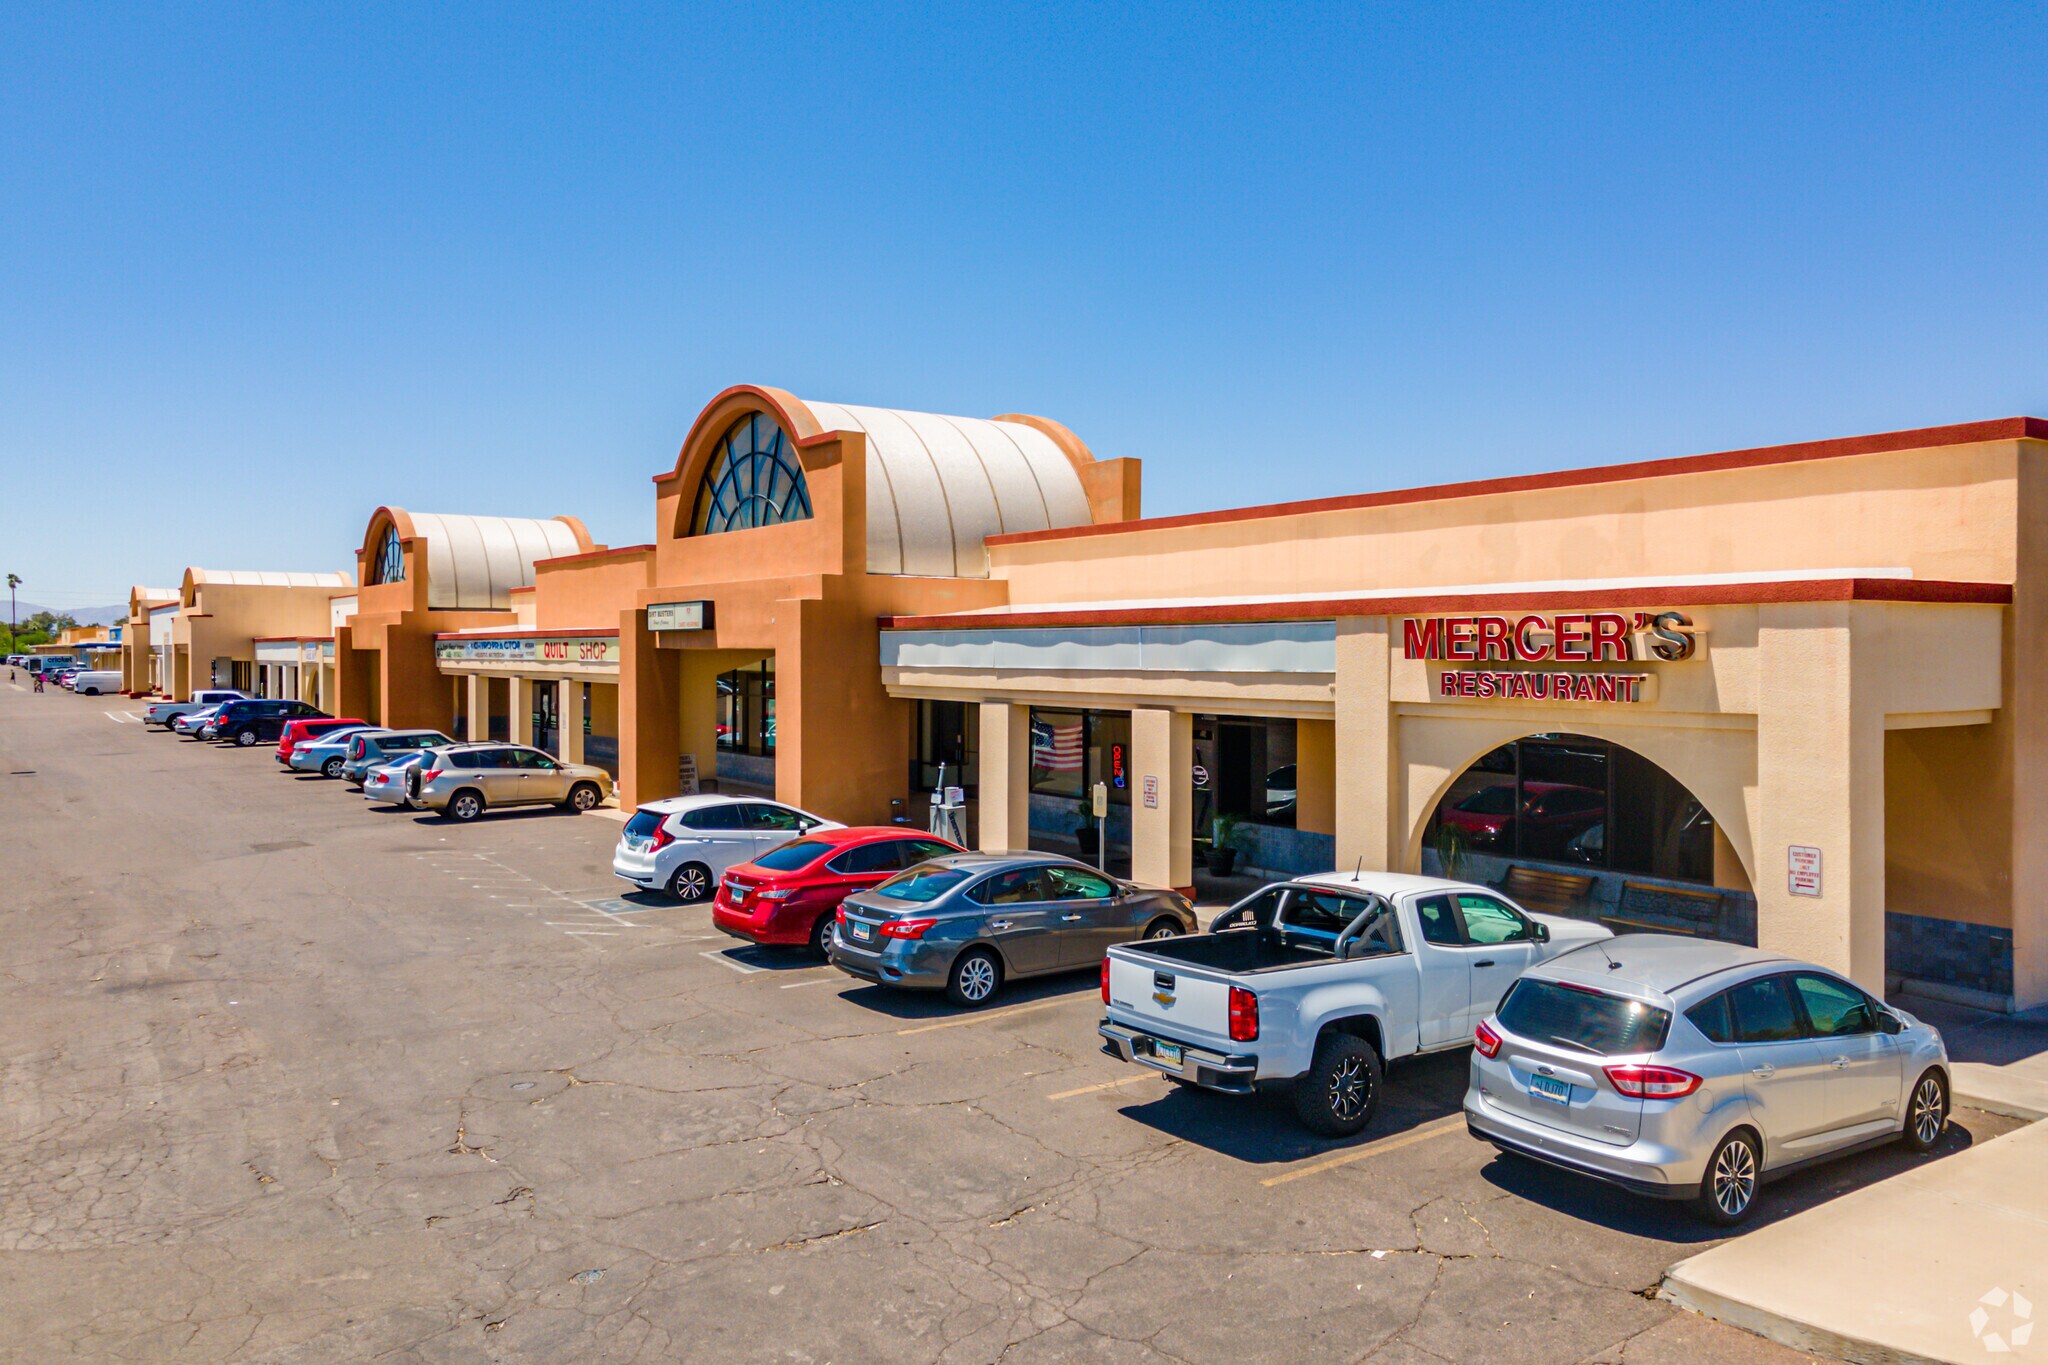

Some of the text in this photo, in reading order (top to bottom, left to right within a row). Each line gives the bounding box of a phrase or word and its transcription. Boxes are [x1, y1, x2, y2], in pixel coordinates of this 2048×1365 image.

[544, 642, 607, 659] QUILT SHOP
[1403, 612, 1696, 661] MERCER'S
[1440, 670, 1642, 703] RESTAURANT
[1113, 745, 1122, 777] OPEN
